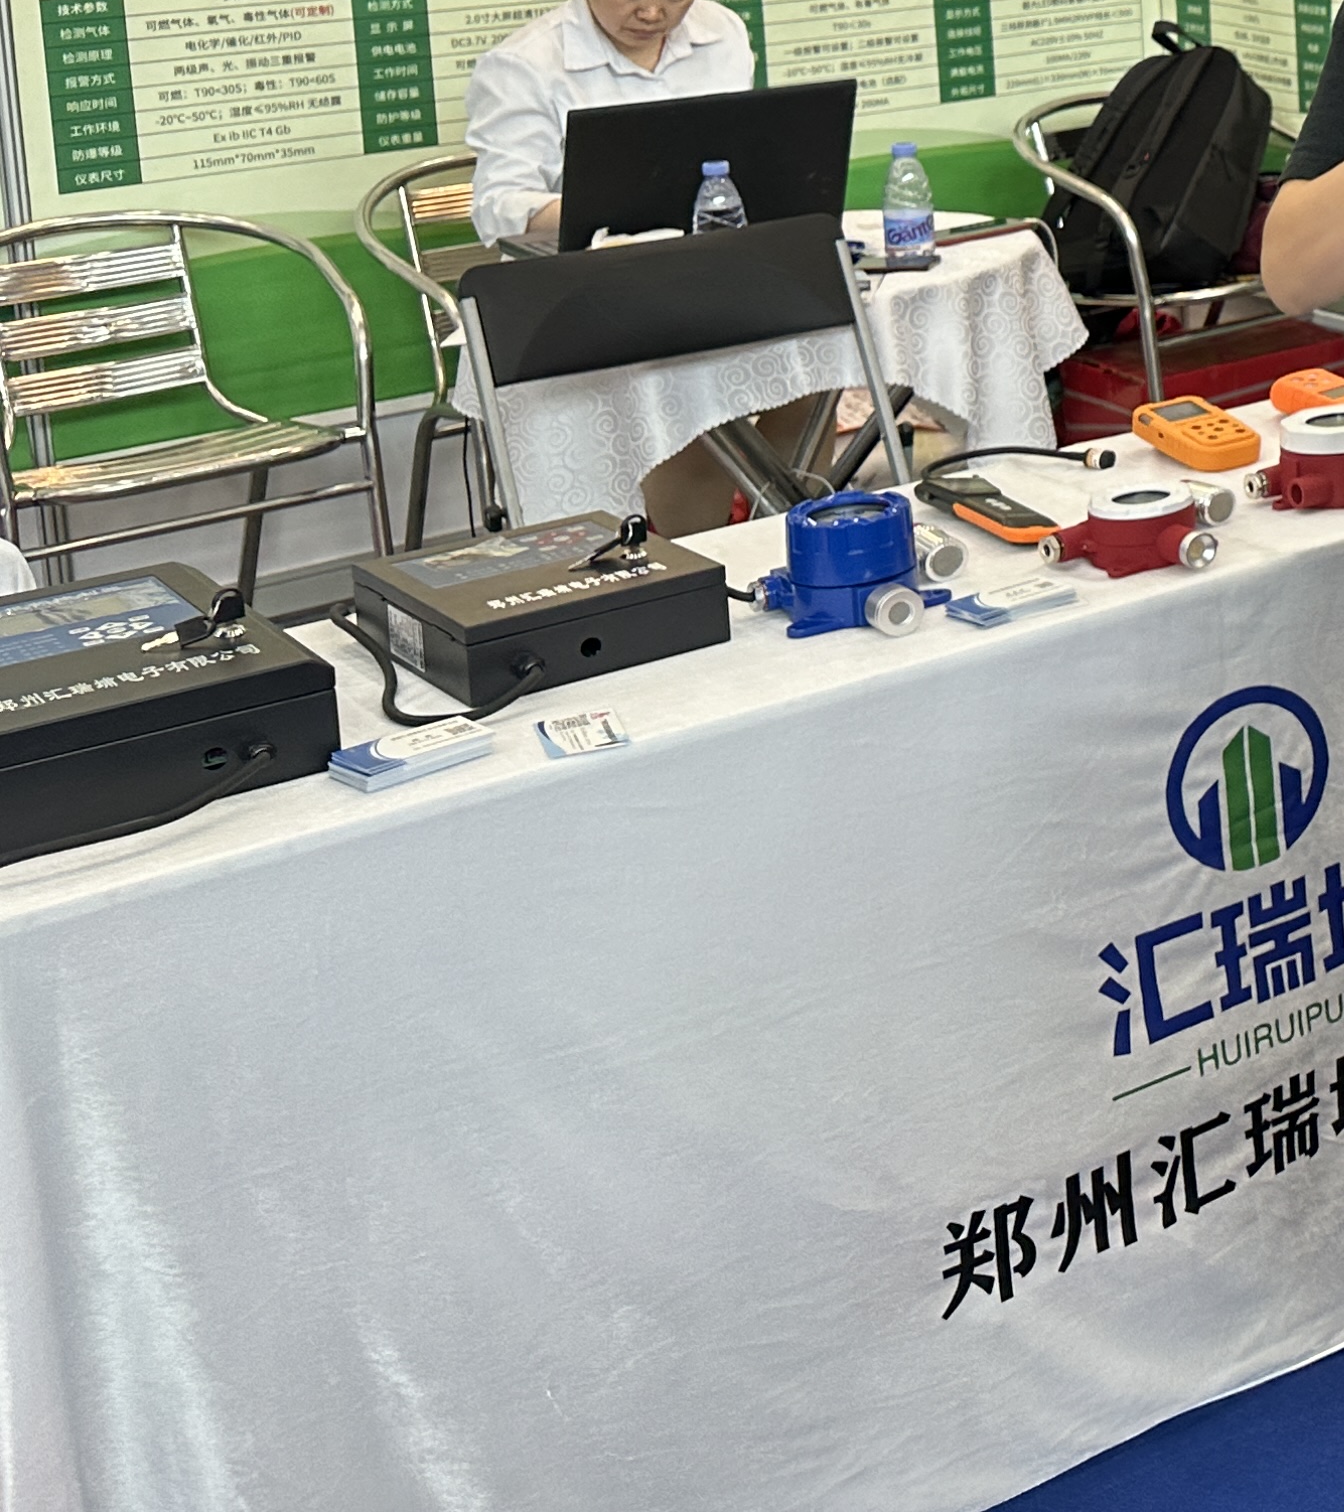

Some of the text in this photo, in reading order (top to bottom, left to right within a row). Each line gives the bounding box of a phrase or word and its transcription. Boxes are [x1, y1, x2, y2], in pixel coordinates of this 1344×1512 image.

[57, 1, 108, 17] 技术参数
[60, 24, 111, 40] 检测气体
[62, 48, 113, 65] 检测原理
[64, 73, 115, 89] 报警方式
[66, 97, 117, 114] 响应时间
[70, 121, 120, 137] 工作环境
[72, 145, 123, 162] 防爆等级
[74, 169, 125, 186] 仪表尺寸
[1196, 993, 1344, 1077] HUIRUIPU
